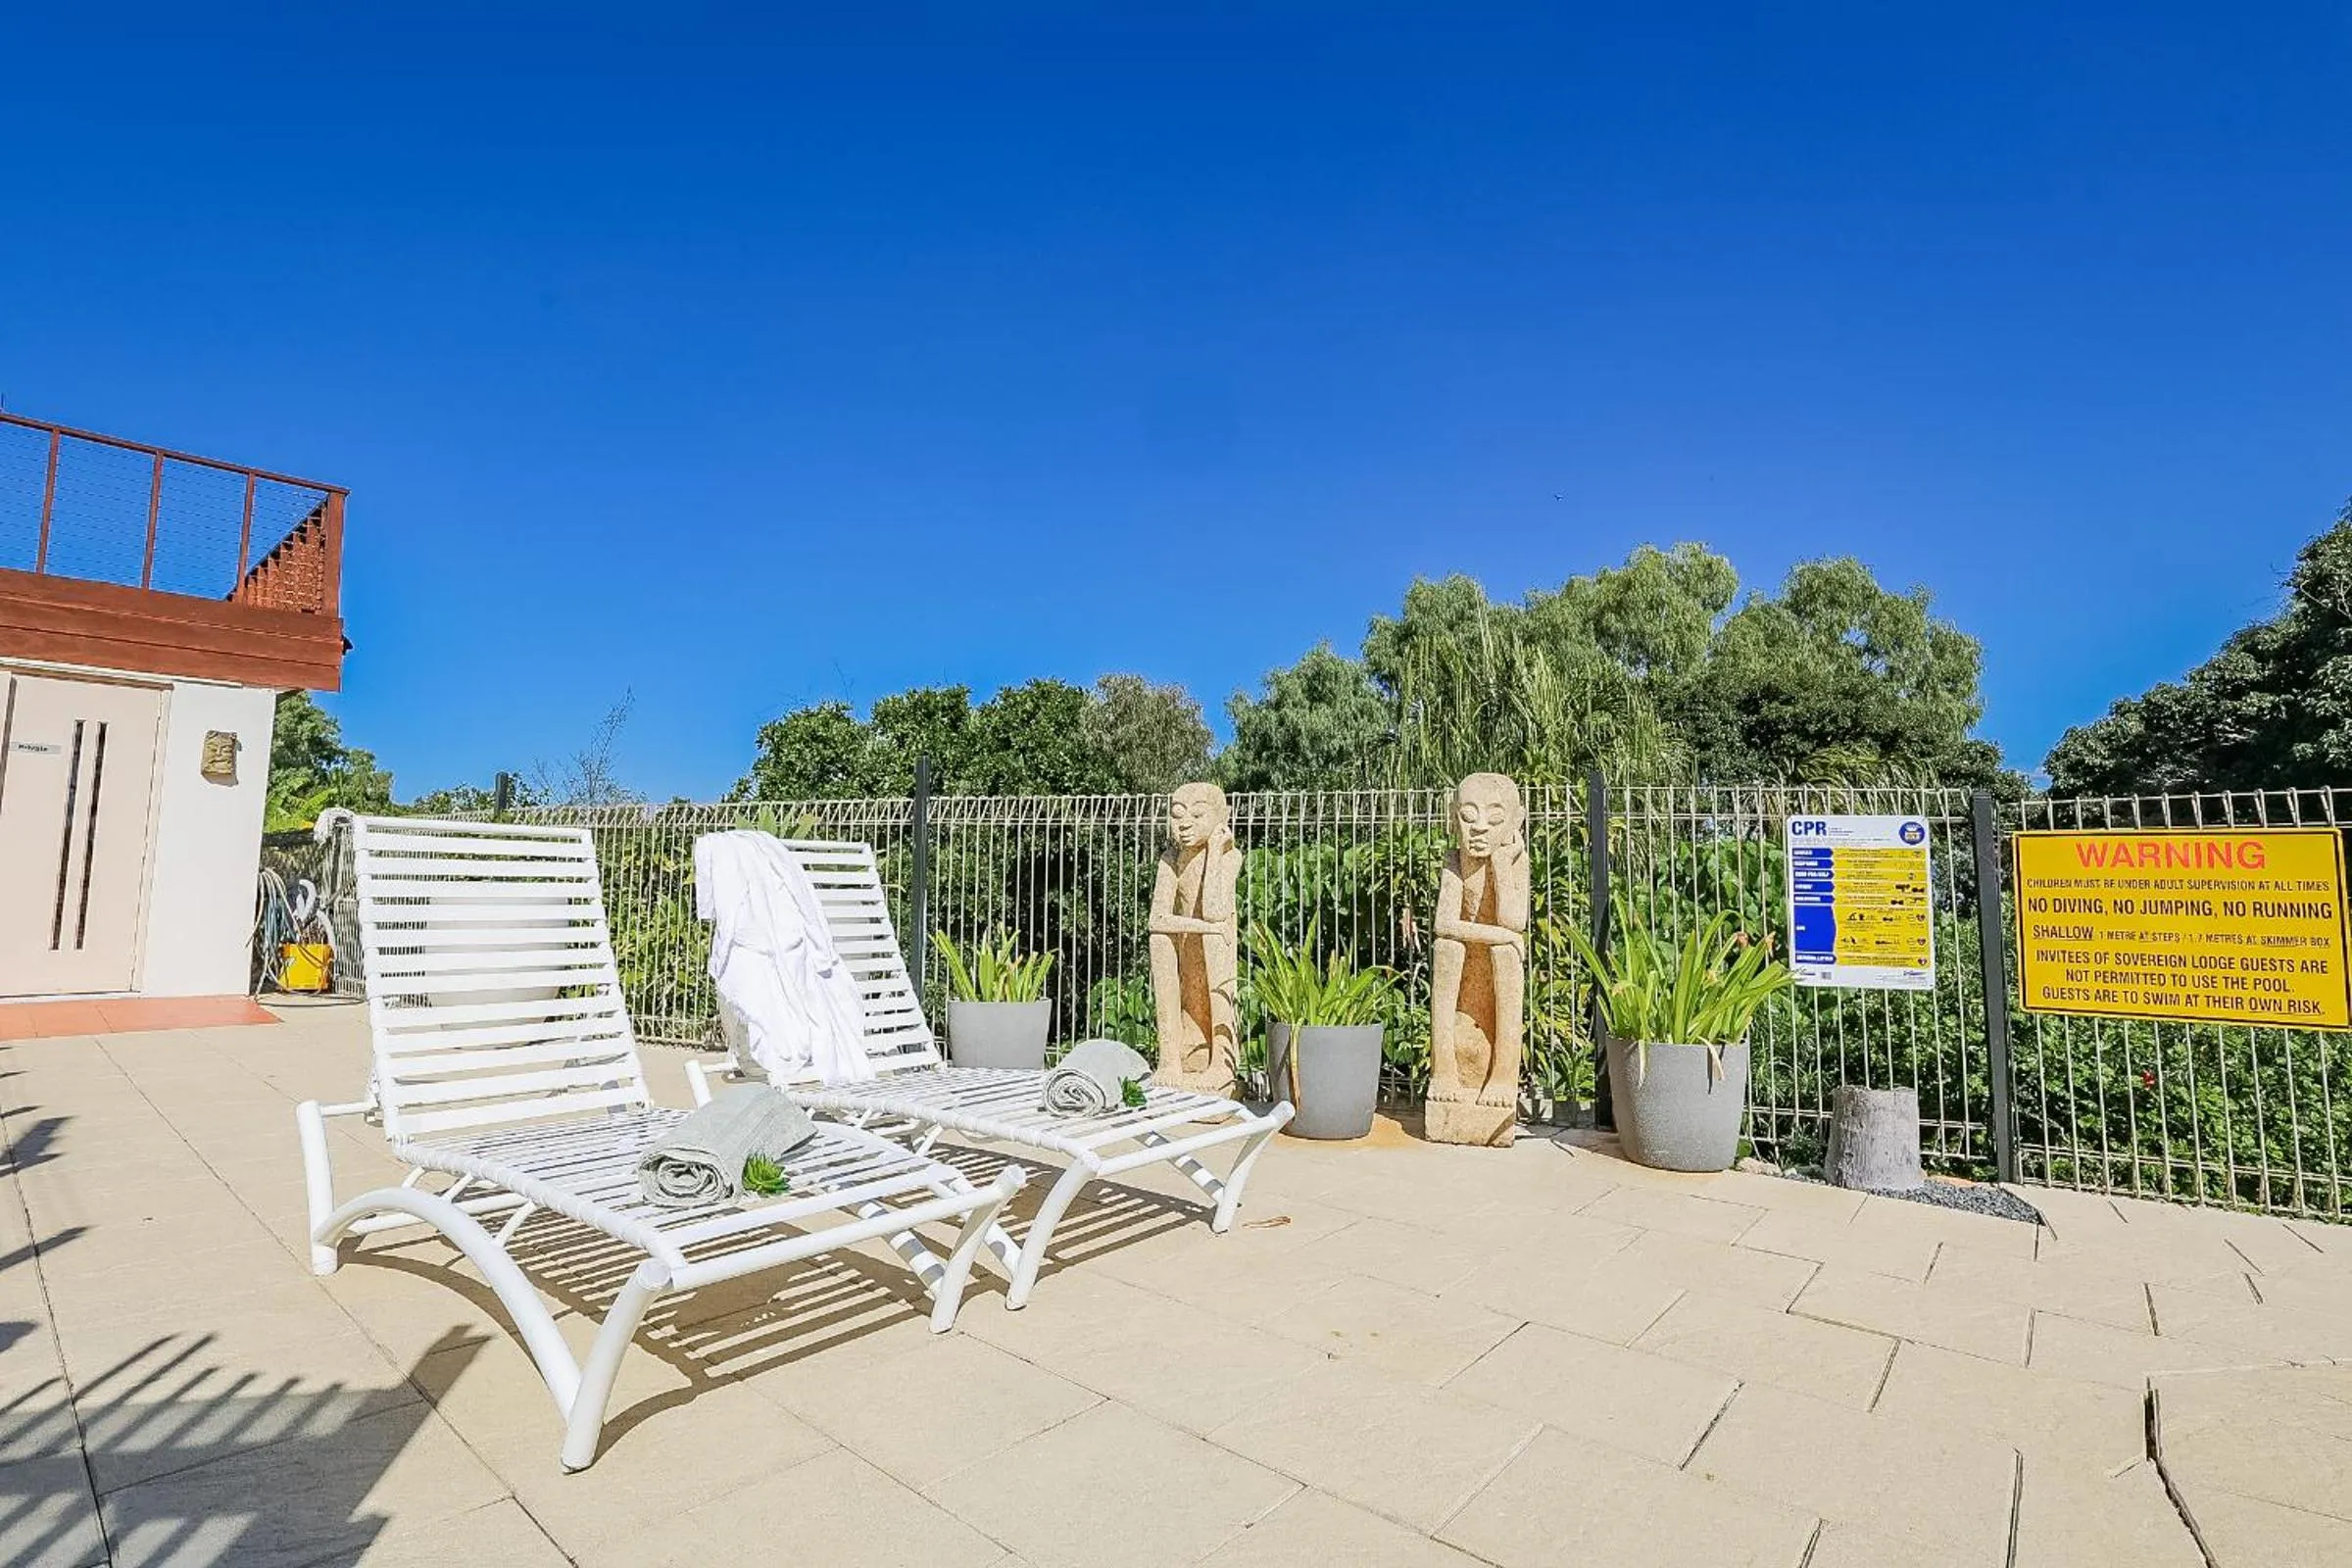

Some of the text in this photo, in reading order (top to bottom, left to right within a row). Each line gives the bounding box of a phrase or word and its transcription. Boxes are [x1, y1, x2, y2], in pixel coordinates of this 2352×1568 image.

[1791, 821, 1827, 836] CPR
[2076, 841, 2265, 869] WARNING
[2027, 878, 2329, 892] CHILDREN MUST BE UNDER ADULT SUPERVISION AT ALL TIMES
[2029, 898, 2332, 919] NO DIVING, NO JUMPING, NO RUNNING
[2033, 925, 2093, 940] SHALLOW
[2106, 931, 2136, 941] METRE
[2139, 931, 2150, 942] AT
[2152, 932, 2180, 943] STEPS
[2205, 934, 2243, 945] METRES
[2245, 935, 2258, 945] AT
[2261, 936, 2307, 947] SKIMMER
[2310, 937, 2329, 948] BOX
[2036, 951, 2328, 974] INVITEES OF SOVEREIGN LODGE GUESTS ARE
[2066, 969, 2295, 993] NOT PERMITTED TO USE THE POOL.
[2042, 987, 2326, 1015] GUESTS ARE TO SWIM AT THEIR OWN RISK.
